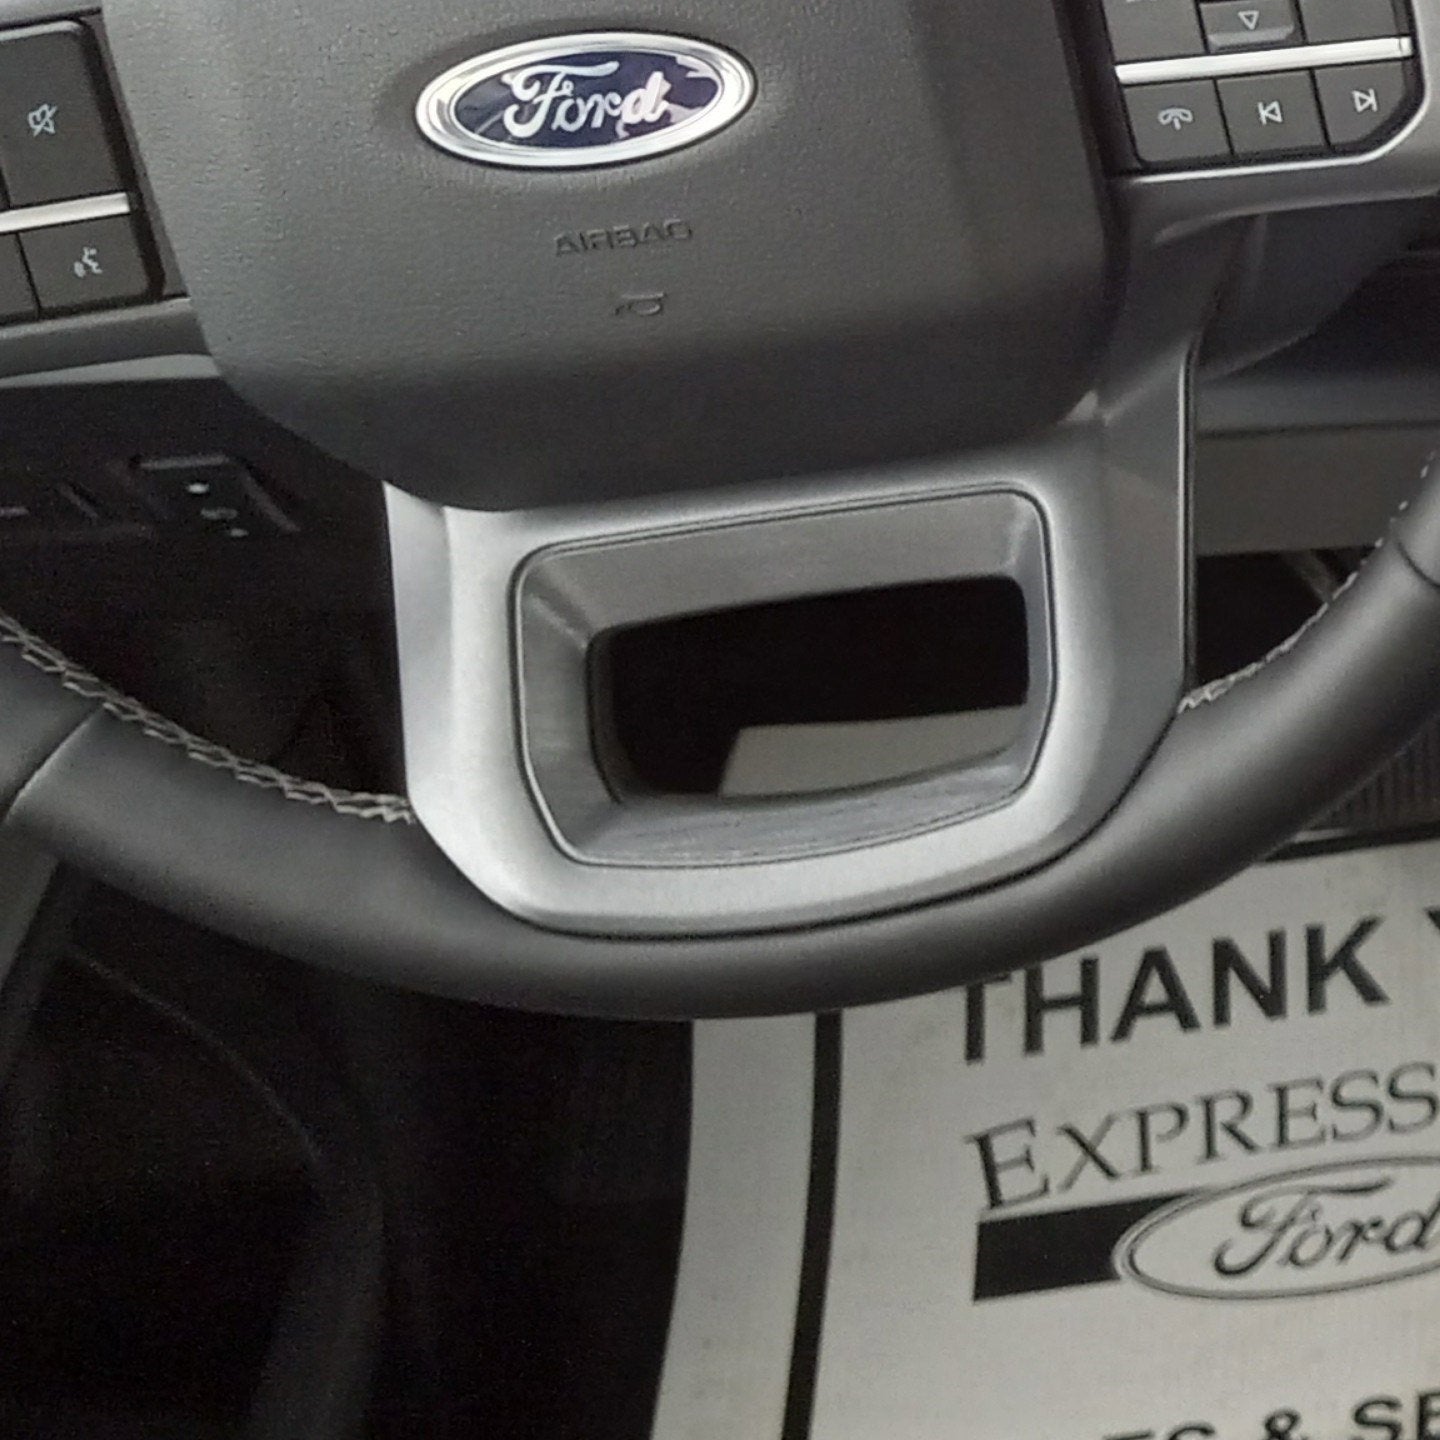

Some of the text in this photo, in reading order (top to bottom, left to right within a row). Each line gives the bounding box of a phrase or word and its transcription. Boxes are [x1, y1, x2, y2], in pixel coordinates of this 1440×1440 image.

[501, 59, 671, 139] Ford
[554, 217, 695, 259] AIRBAG
[961, 913, 1395, 1066] THANK
